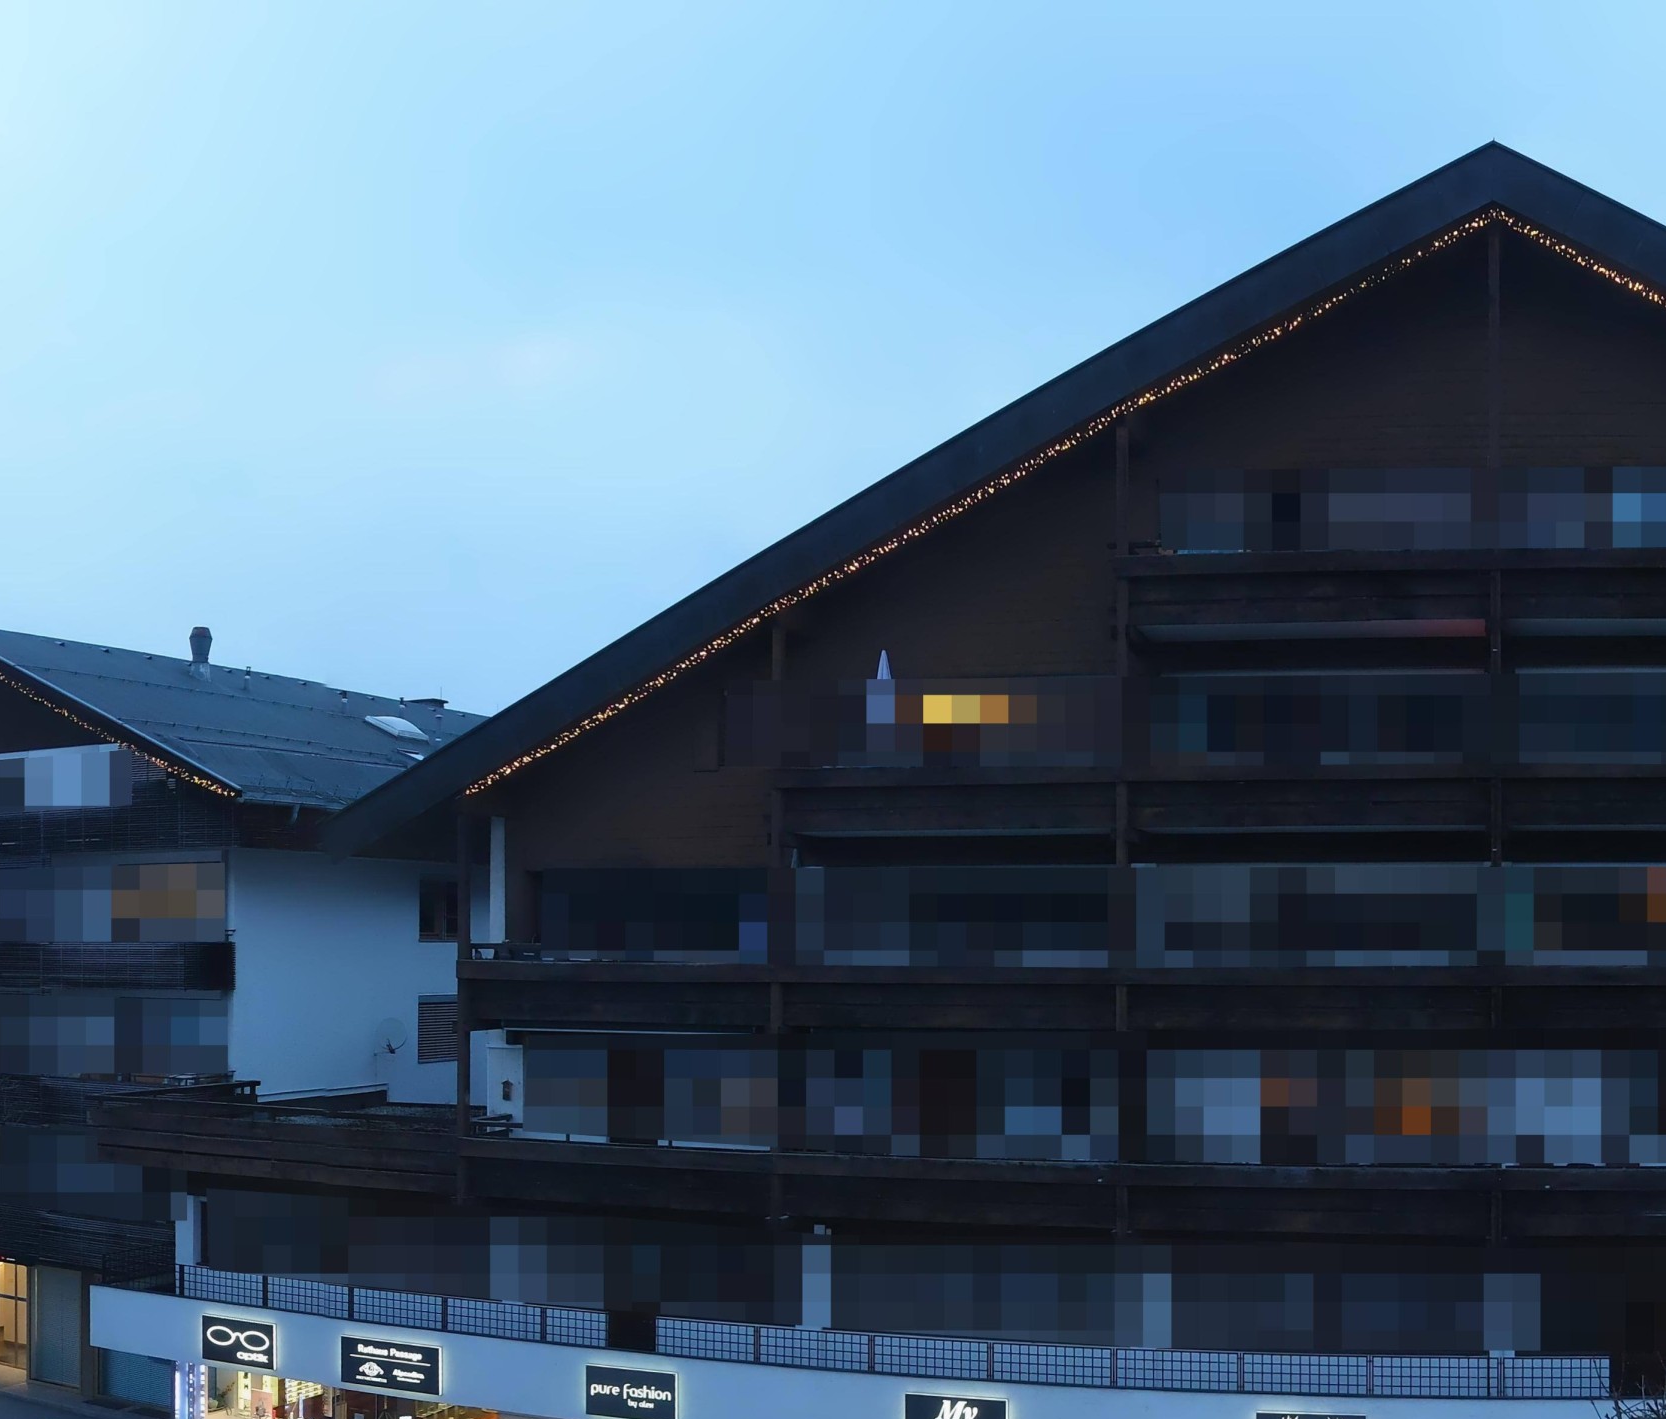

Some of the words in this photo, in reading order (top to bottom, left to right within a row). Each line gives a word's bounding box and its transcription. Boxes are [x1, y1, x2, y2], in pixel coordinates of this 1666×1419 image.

[236, 1351, 269, 1364] optik
[357, 1343, 389, 1356] Rathaus
[389, 1348, 423, 1361] Passage
[590, 1384, 621, 1396] pure
[623, 1383, 672, 1401] fashion
